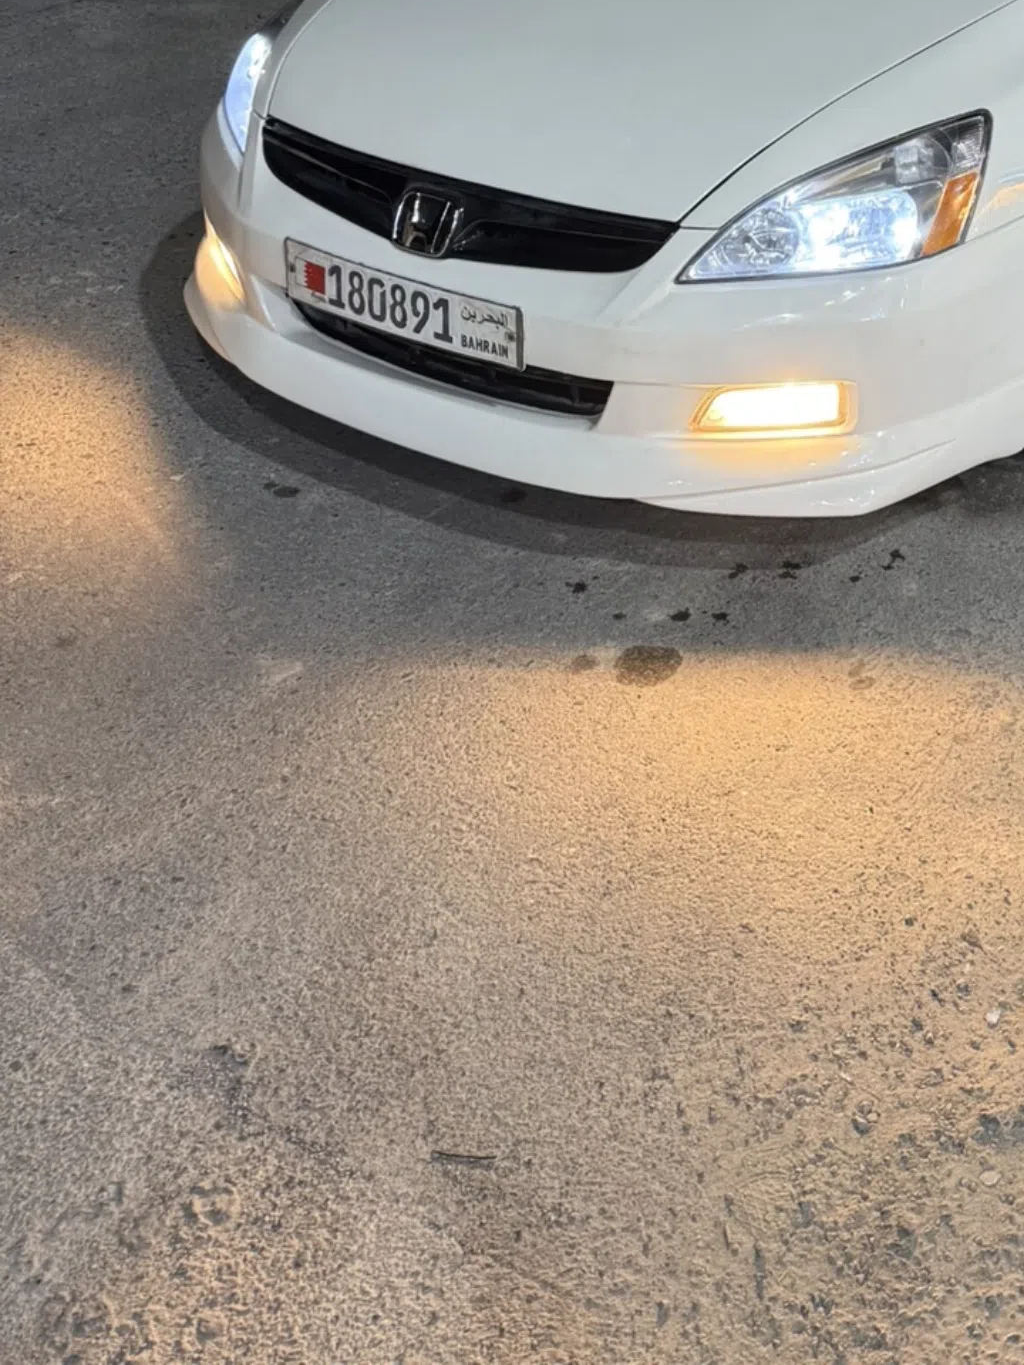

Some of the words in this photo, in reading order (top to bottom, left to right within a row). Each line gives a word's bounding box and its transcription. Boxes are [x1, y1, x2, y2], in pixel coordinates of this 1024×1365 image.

[328, 265, 453, 343] 180891
[460, 303, 508, 331] البحرين
[461, 335, 509, 358] BAHRAIN
